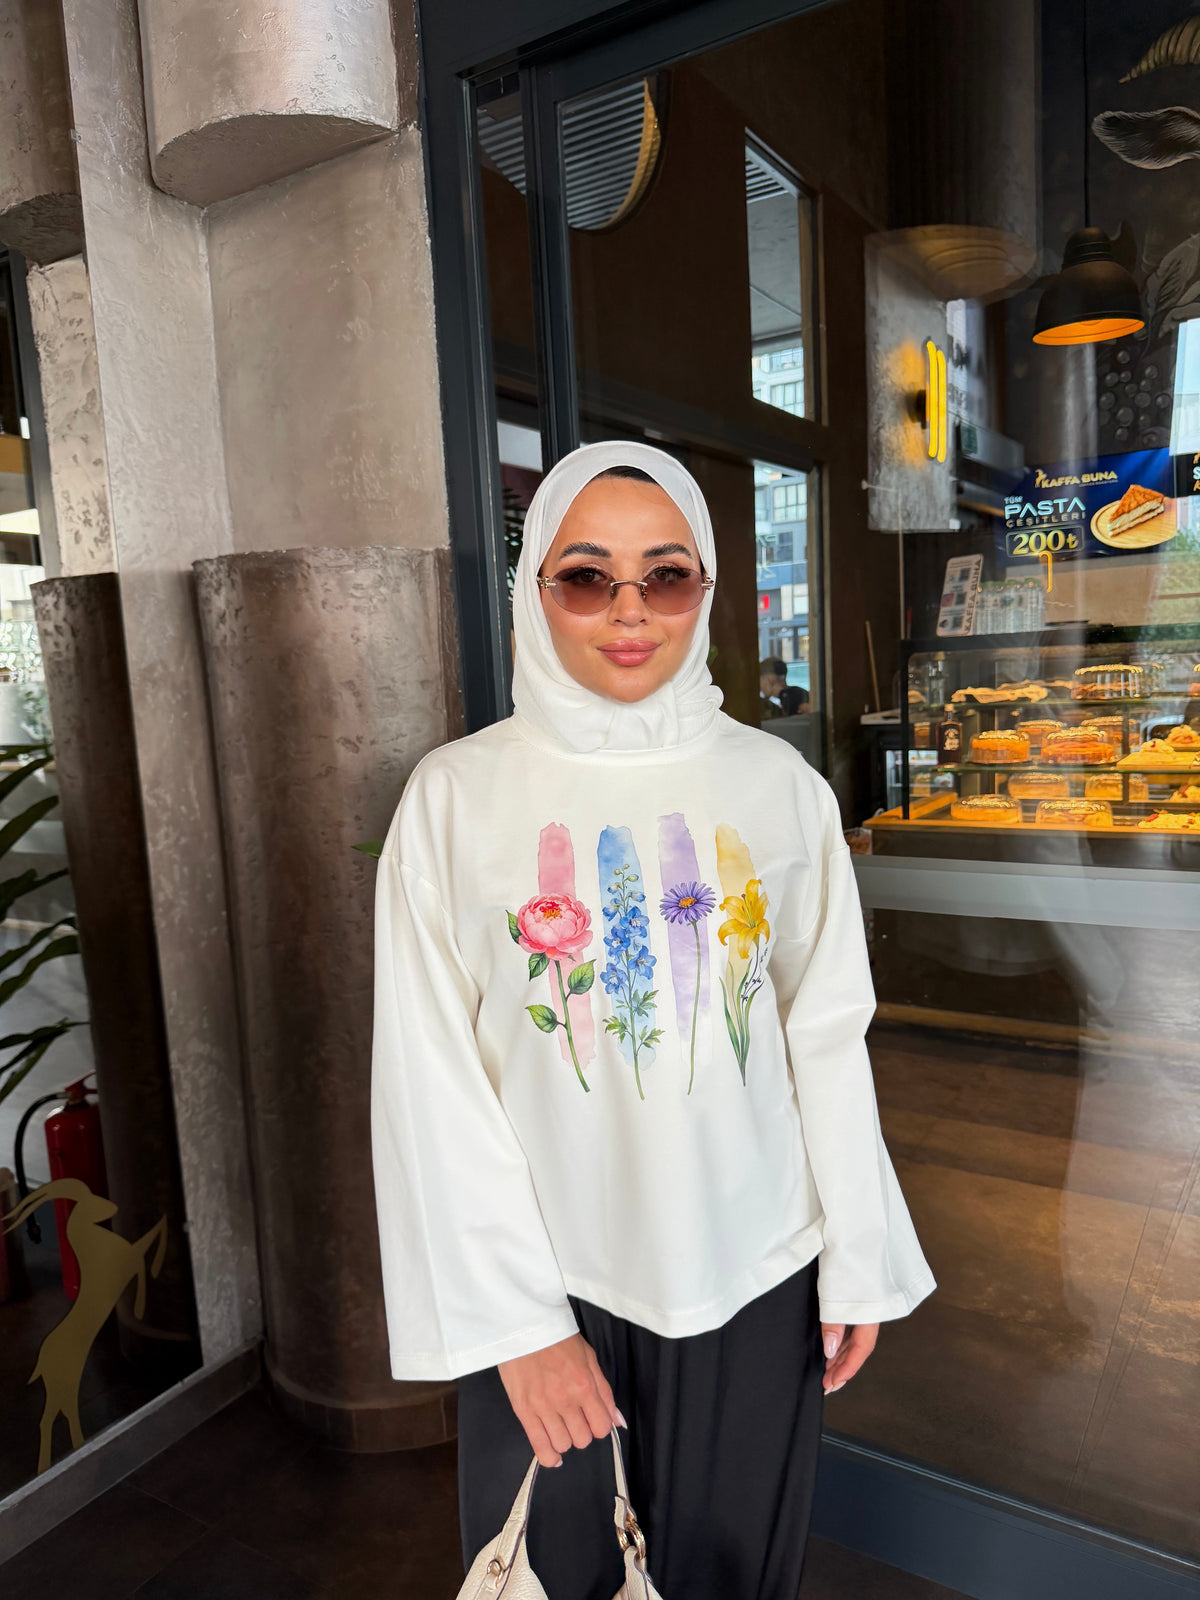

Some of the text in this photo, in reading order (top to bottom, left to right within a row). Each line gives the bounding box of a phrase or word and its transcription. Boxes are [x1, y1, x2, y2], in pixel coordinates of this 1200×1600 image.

[1041, 476, 1080, 488] KAFFA
[1081, 471, 1118, 483] BUNA
[1004, 497, 1086, 520] PASTA
